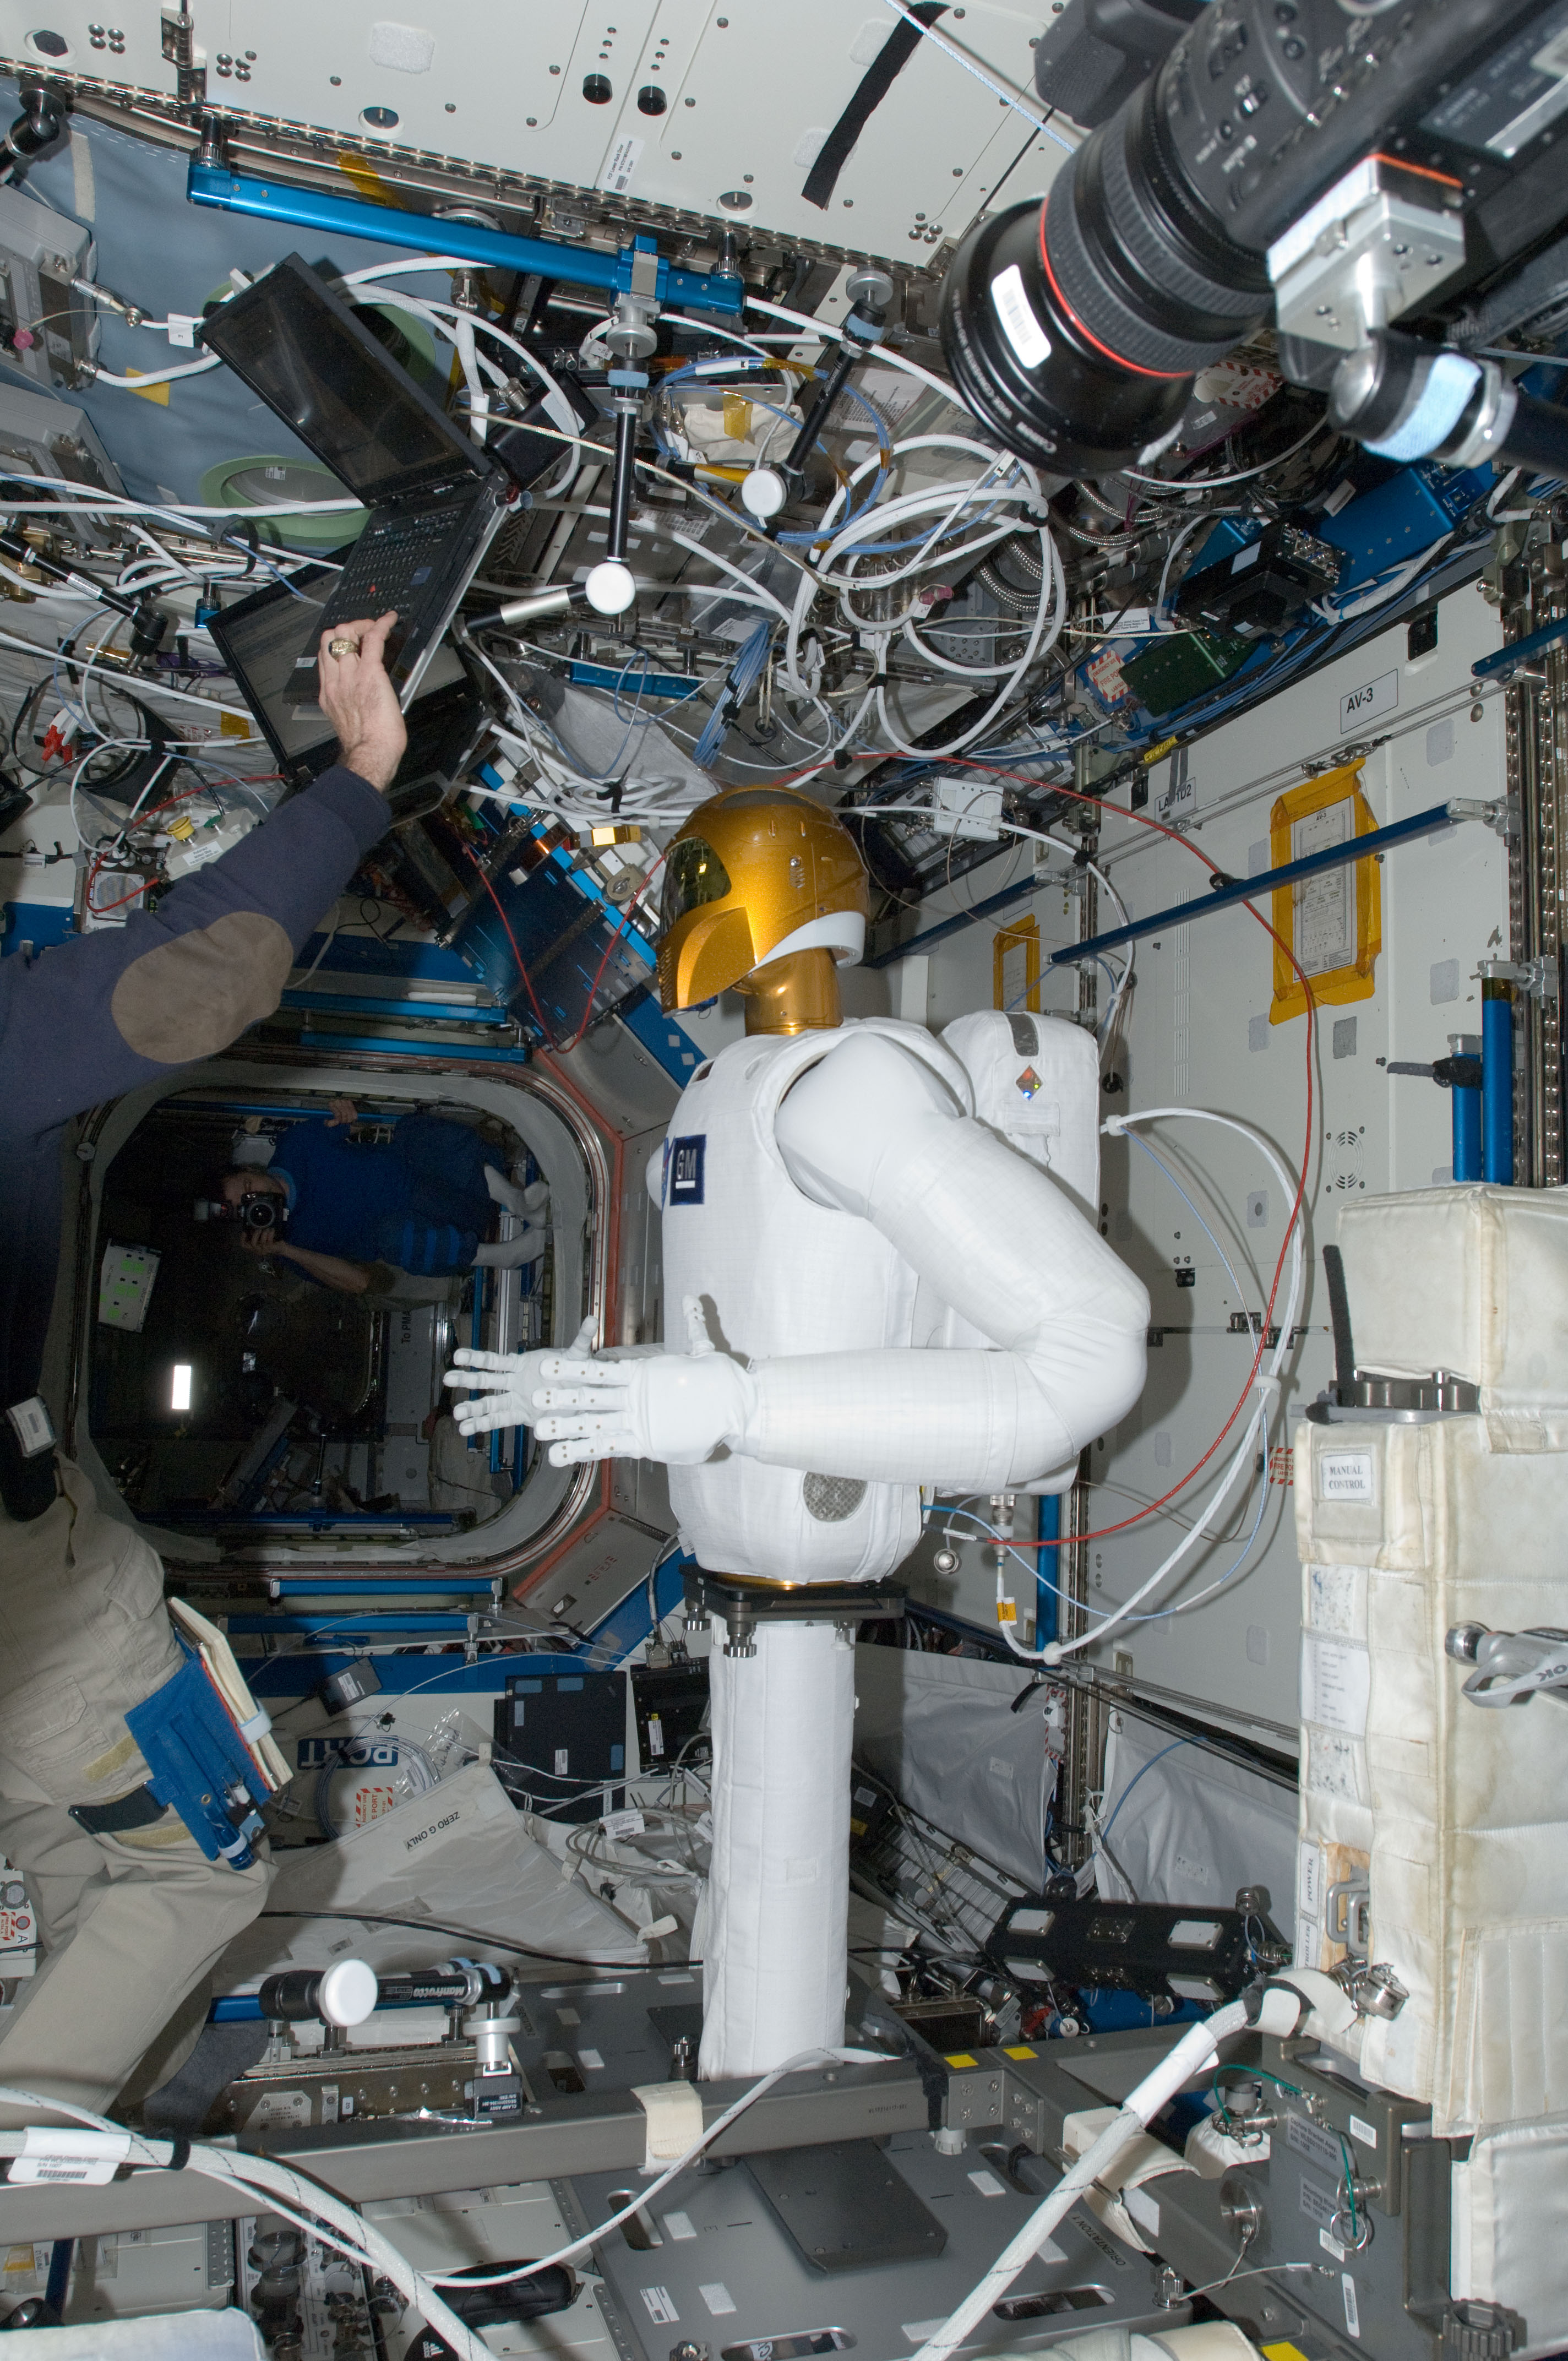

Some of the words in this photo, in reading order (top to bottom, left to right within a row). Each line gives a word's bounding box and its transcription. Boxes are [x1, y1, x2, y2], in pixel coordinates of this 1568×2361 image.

[1092, 662, 1110, 678] EMERGENCY
[1100, 674, 1112, 687] FIRE
[1110, 667, 1121, 680] POR
[1347, 687, 1374, 714] AV-3
[1158, 784, 1192, 812] LA1D2
[1316, 812, 1327, 822] AV-3
[676, 1149, 697, 1180] GM
[401, 1310, 411, 1330] PMA
[401, 1333, 411, 1343] To
[1330, 1465, 1363, 1476] MANUAL
[1329, 1479, 1365, 1490] CONTROL
[428, 1825, 437, 1835] G
[437, 1811, 460, 1830] ZERO
[406, 1829, 429, 1850] ONLY
[17, 1934, 28, 1944] A
[413, 1985, 465, 1998] Manfrotto
[1290, 2117, 1308, 2133] Capture
[1308, 2128, 1325, 2142] Bracket
[1076, 2220, 1126, 2266] ORIENTATION
